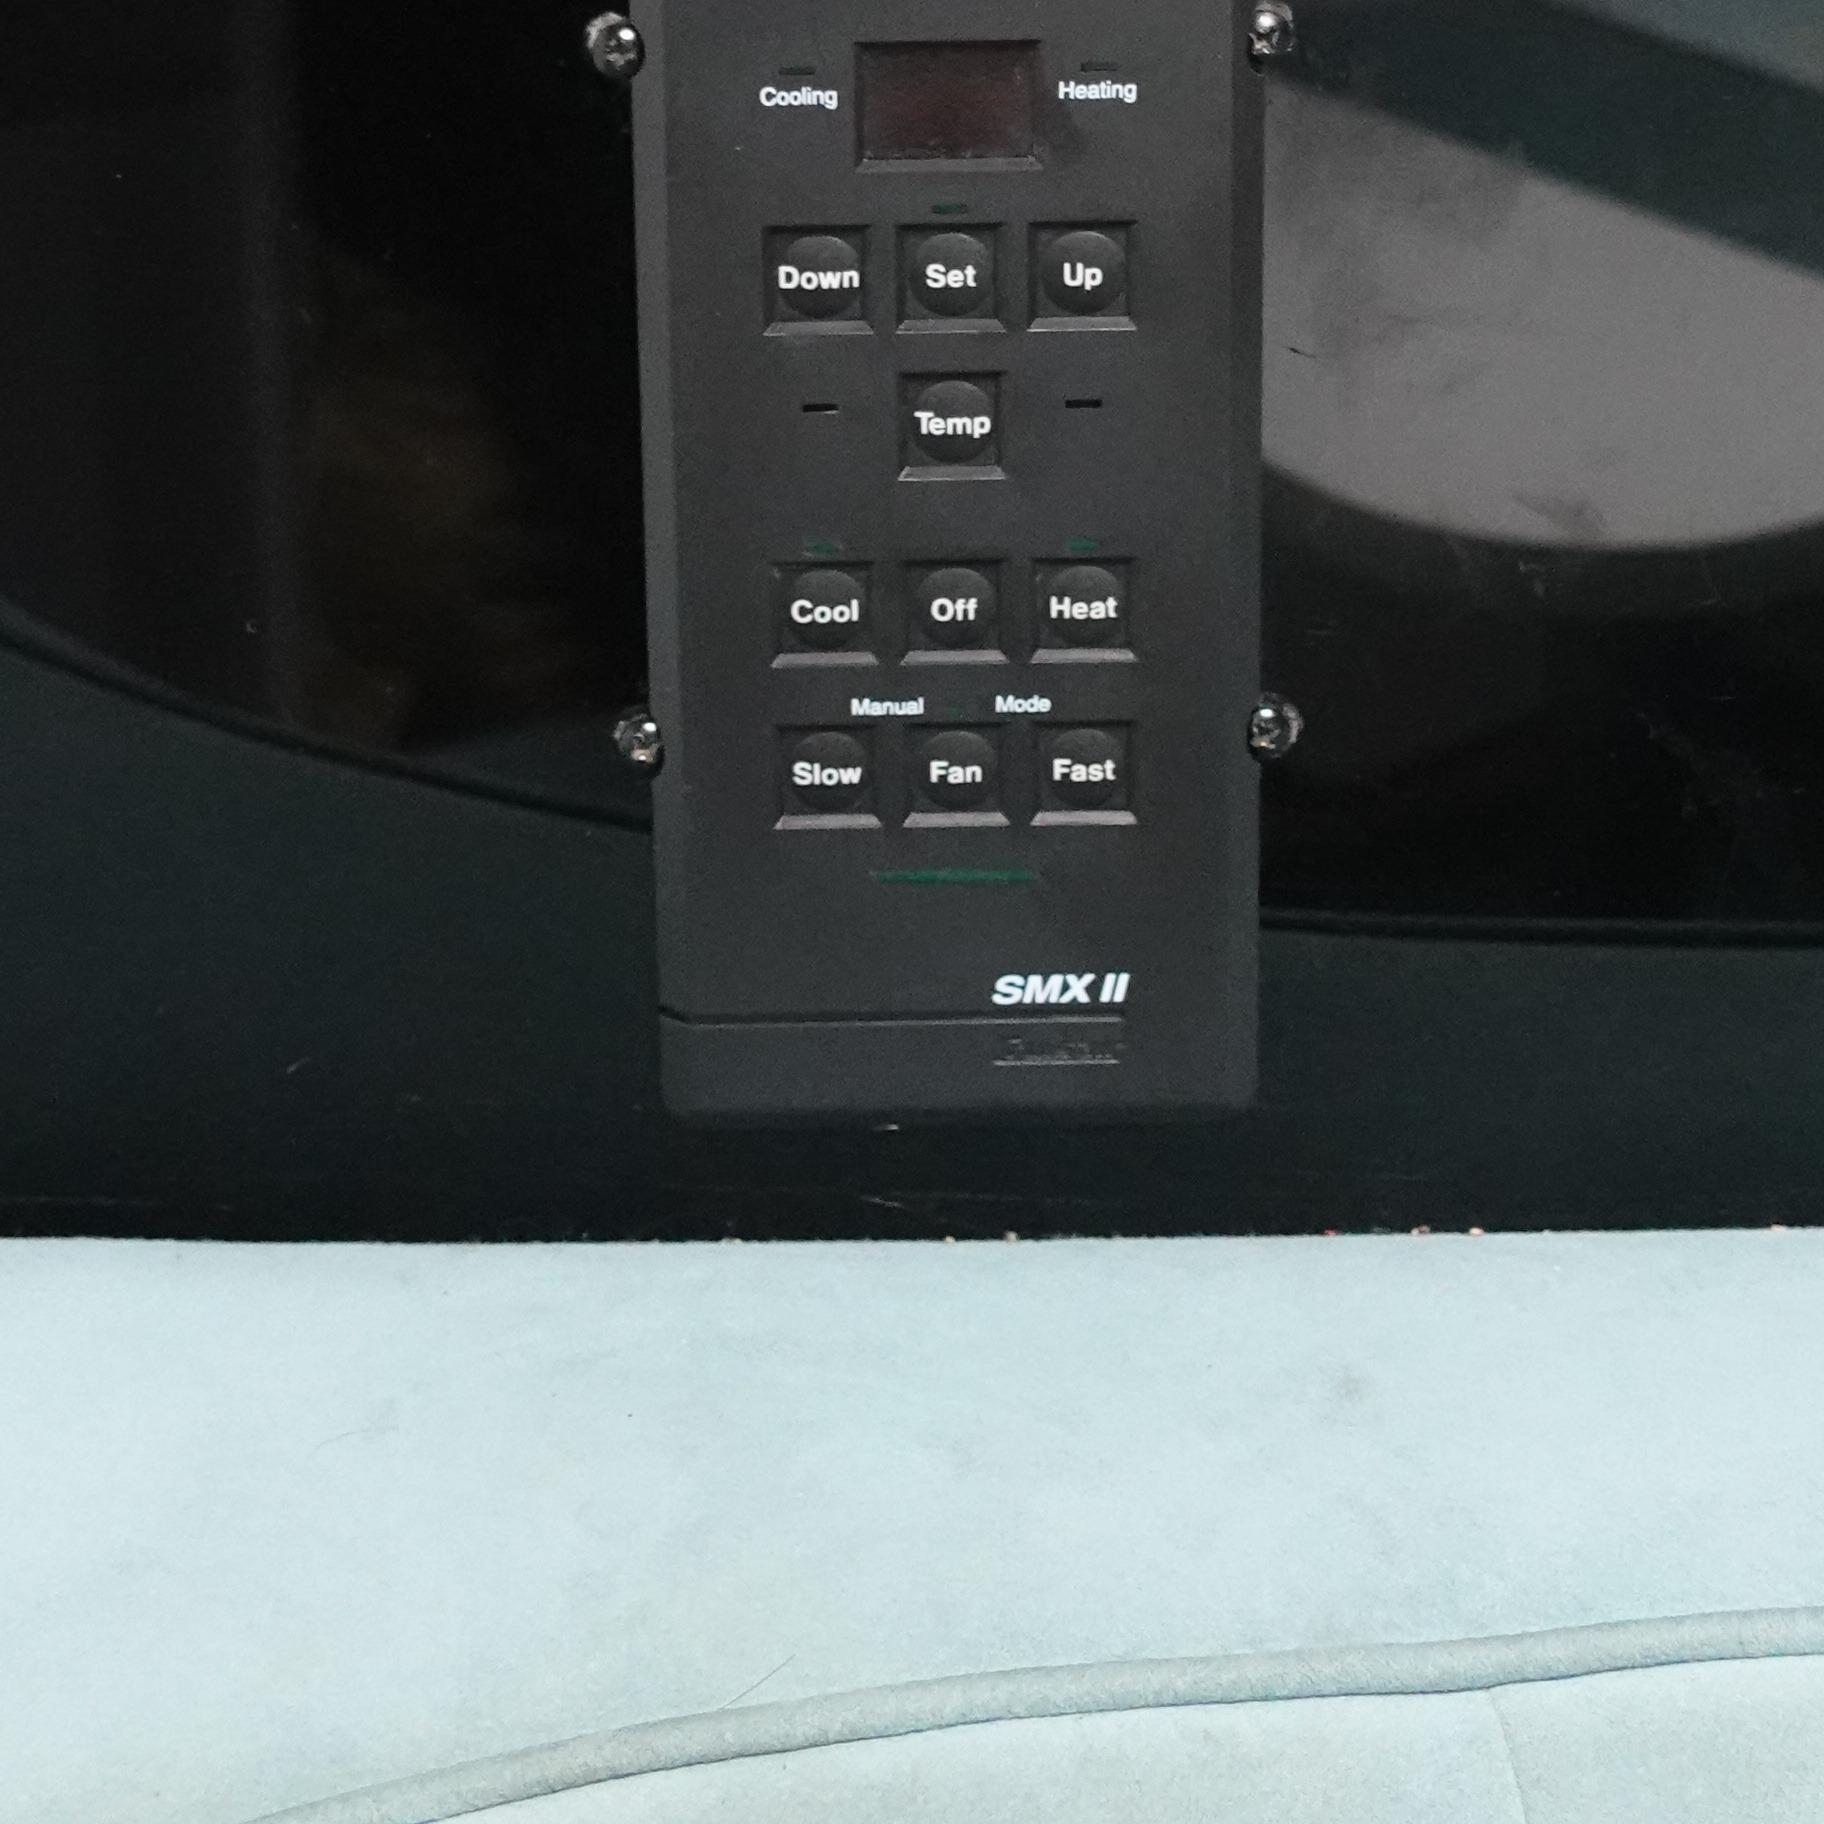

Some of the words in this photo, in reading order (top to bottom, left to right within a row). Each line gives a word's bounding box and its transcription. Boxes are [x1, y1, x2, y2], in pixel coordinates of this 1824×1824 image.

[759, 86, 839, 110] Cooling
[1058, 80, 1138, 104] Heating
[777, 265, 861, 291] Down
[925, 263, 977, 290] Set
[1063, 262, 1104, 292] Up
[913, 410, 992, 439] Temp
[790, 598, 860, 625] Cool
[930, 597, 978, 622] Off
[1049, 595, 1118, 621] Heat
[850, 696, 925, 716] Manual
[994, 693, 1052, 714] Mode
[792, 761, 863, 786] Slow
[928, 759, 983, 784] Fan
[1052, 757, 1116, 782] Fast
[991, 973, 1096, 1006] SMX
[1098, 972, 1132, 1004] II
